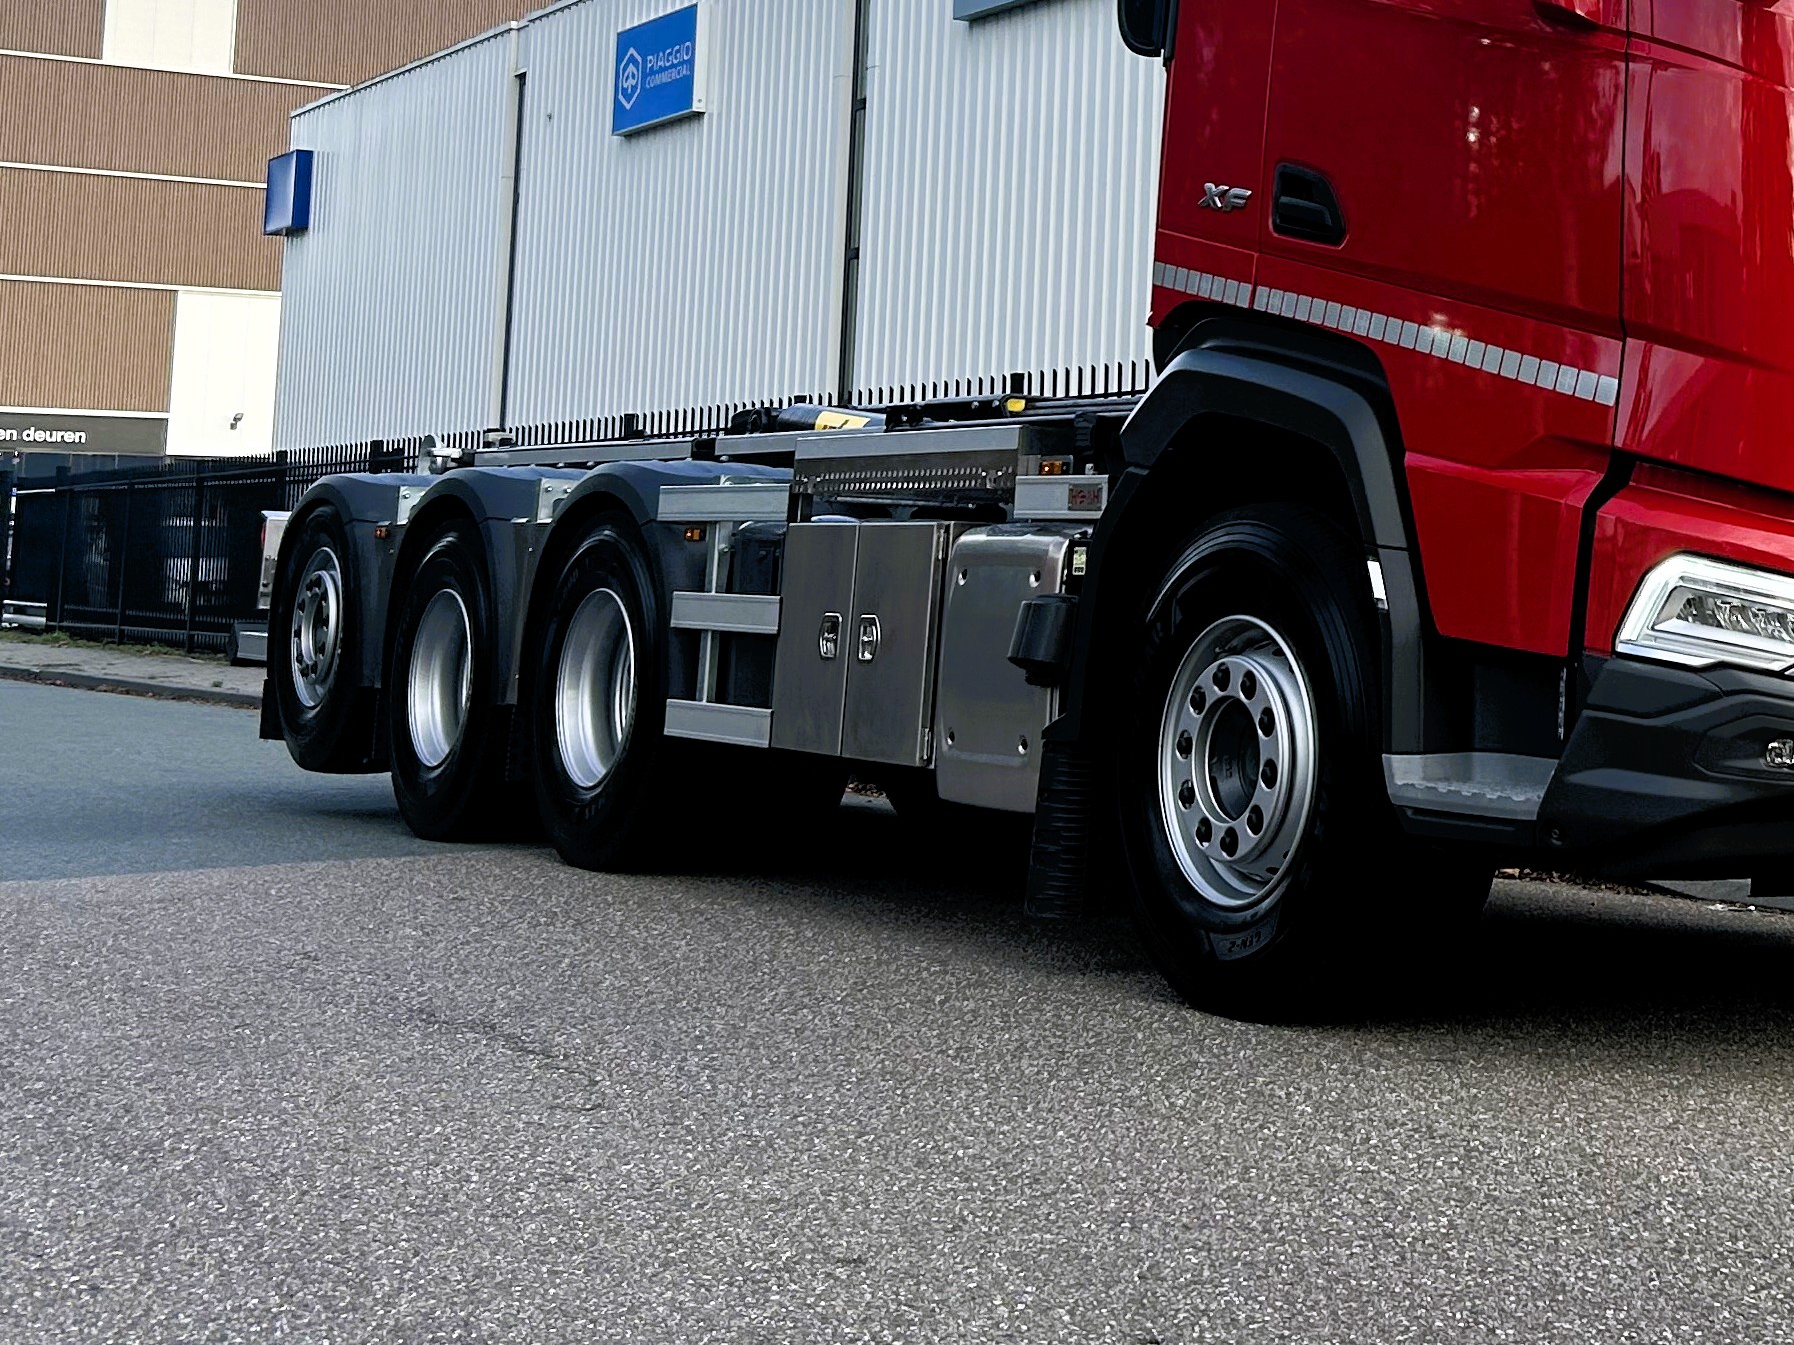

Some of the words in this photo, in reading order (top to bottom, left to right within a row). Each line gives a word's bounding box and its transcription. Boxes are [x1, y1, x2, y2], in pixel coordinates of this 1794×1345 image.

[646, 41, 692, 74] PIAGGIO
[645, 63, 691, 89] COMMERCIAL
[1197, 182, 1253, 212] XF
[22, 426, 87, 444] deuren
